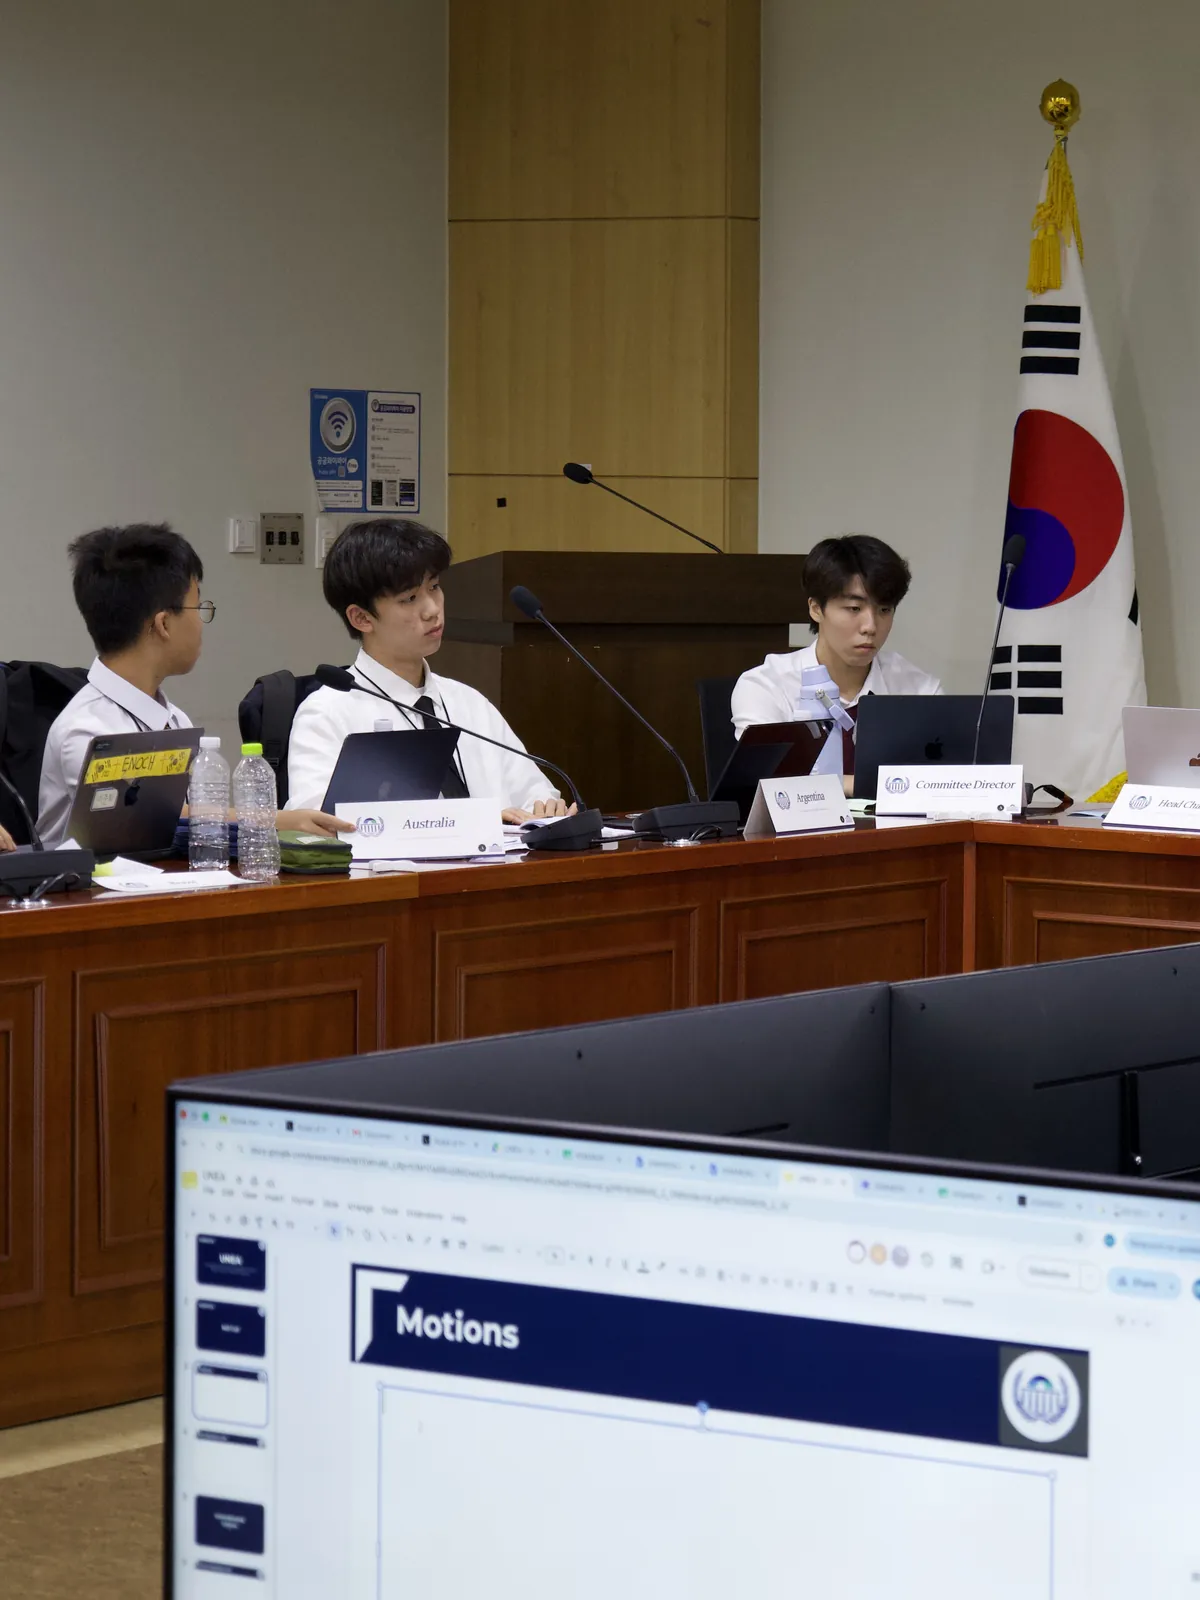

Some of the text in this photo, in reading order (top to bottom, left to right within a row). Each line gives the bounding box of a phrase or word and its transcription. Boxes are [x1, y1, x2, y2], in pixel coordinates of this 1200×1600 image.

[121, 754, 156, 773] ENOCH
[915, 780, 1017, 790] Committee Director
[796, 791, 826, 805] Argentina
[1158, 799, 1184, 808] Head
[402, 816, 456, 830] Australia
[395, 1303, 521, 1350] Motions
